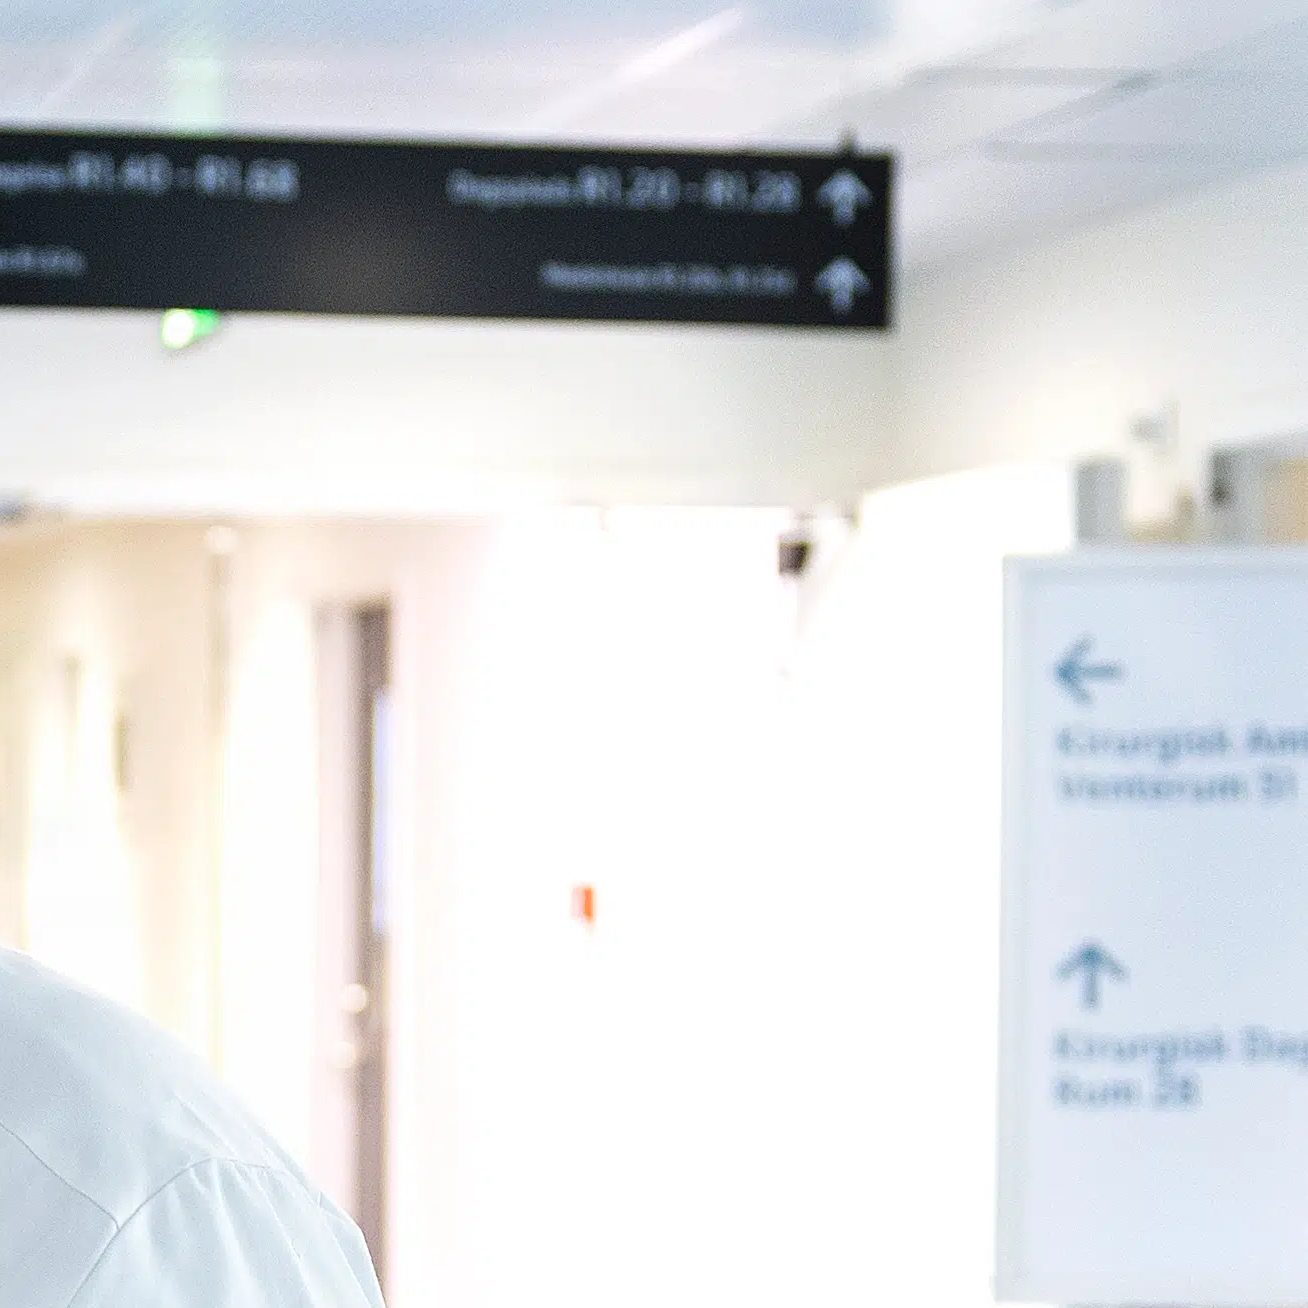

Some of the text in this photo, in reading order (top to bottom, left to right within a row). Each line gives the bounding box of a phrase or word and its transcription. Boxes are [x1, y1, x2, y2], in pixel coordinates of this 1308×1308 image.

[1055, 724, 1234, 767] Kirurgisk
[1056, 771, 1248, 804] Venterum
[1052, 1027, 1231, 1070] Kirurgisk
[1052, 1073, 1141, 1108] Rum
